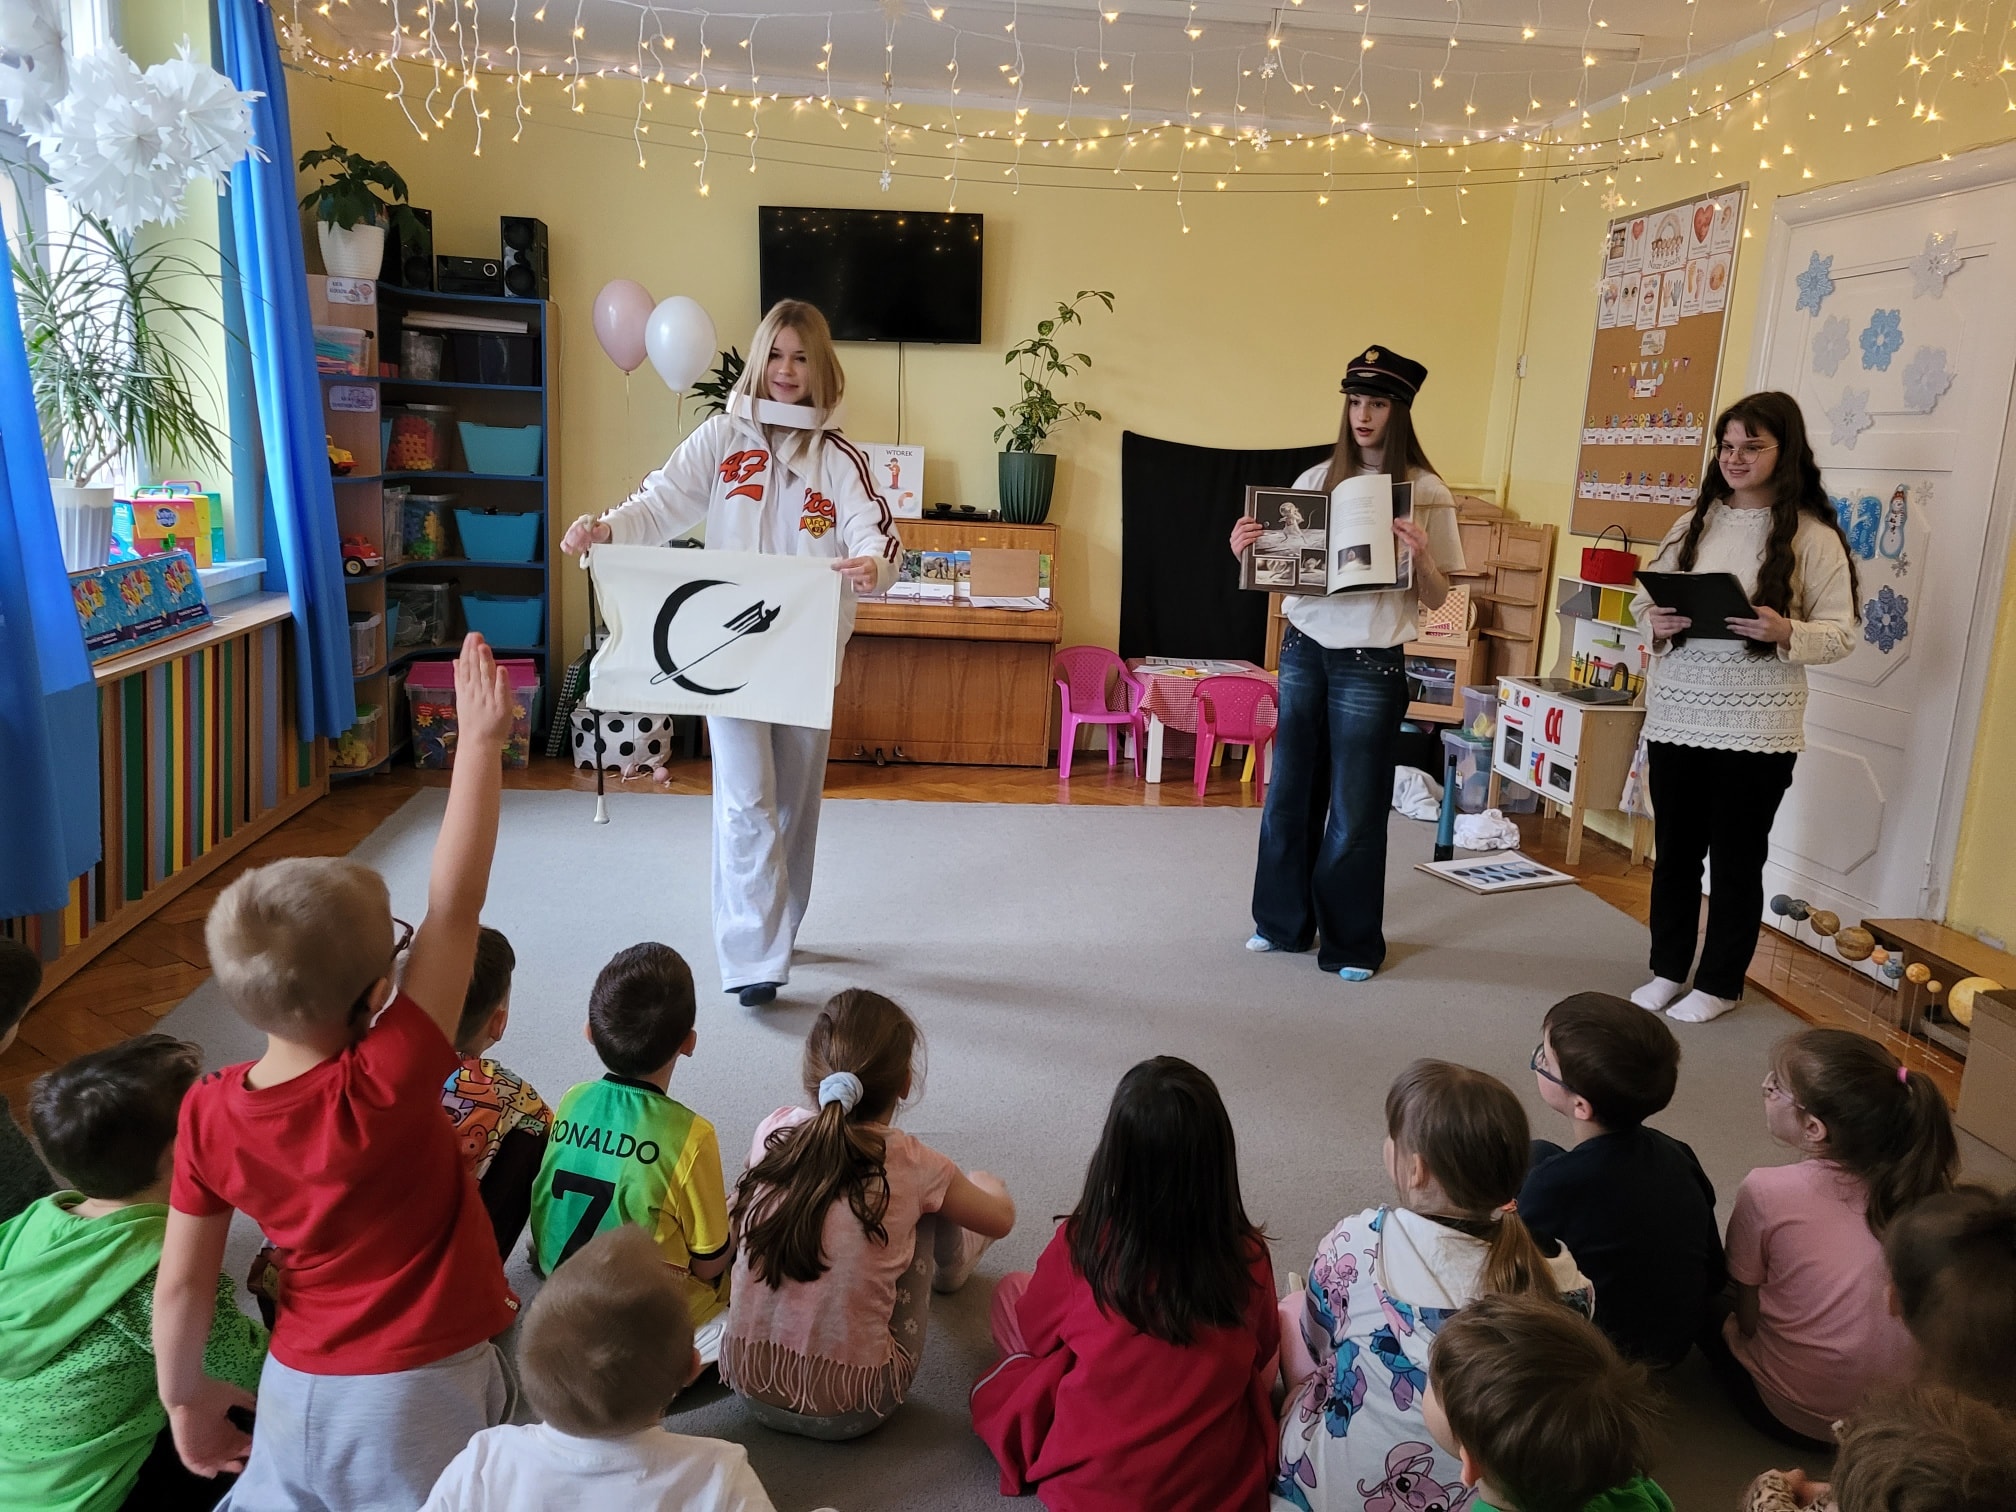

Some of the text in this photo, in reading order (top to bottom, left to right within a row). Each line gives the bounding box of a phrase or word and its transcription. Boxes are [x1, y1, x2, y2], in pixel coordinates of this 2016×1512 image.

[885, 449, 913, 457] WTOREK
[550, 1119, 660, 1165] RONALDO
[551, 1169, 617, 1273] 7
